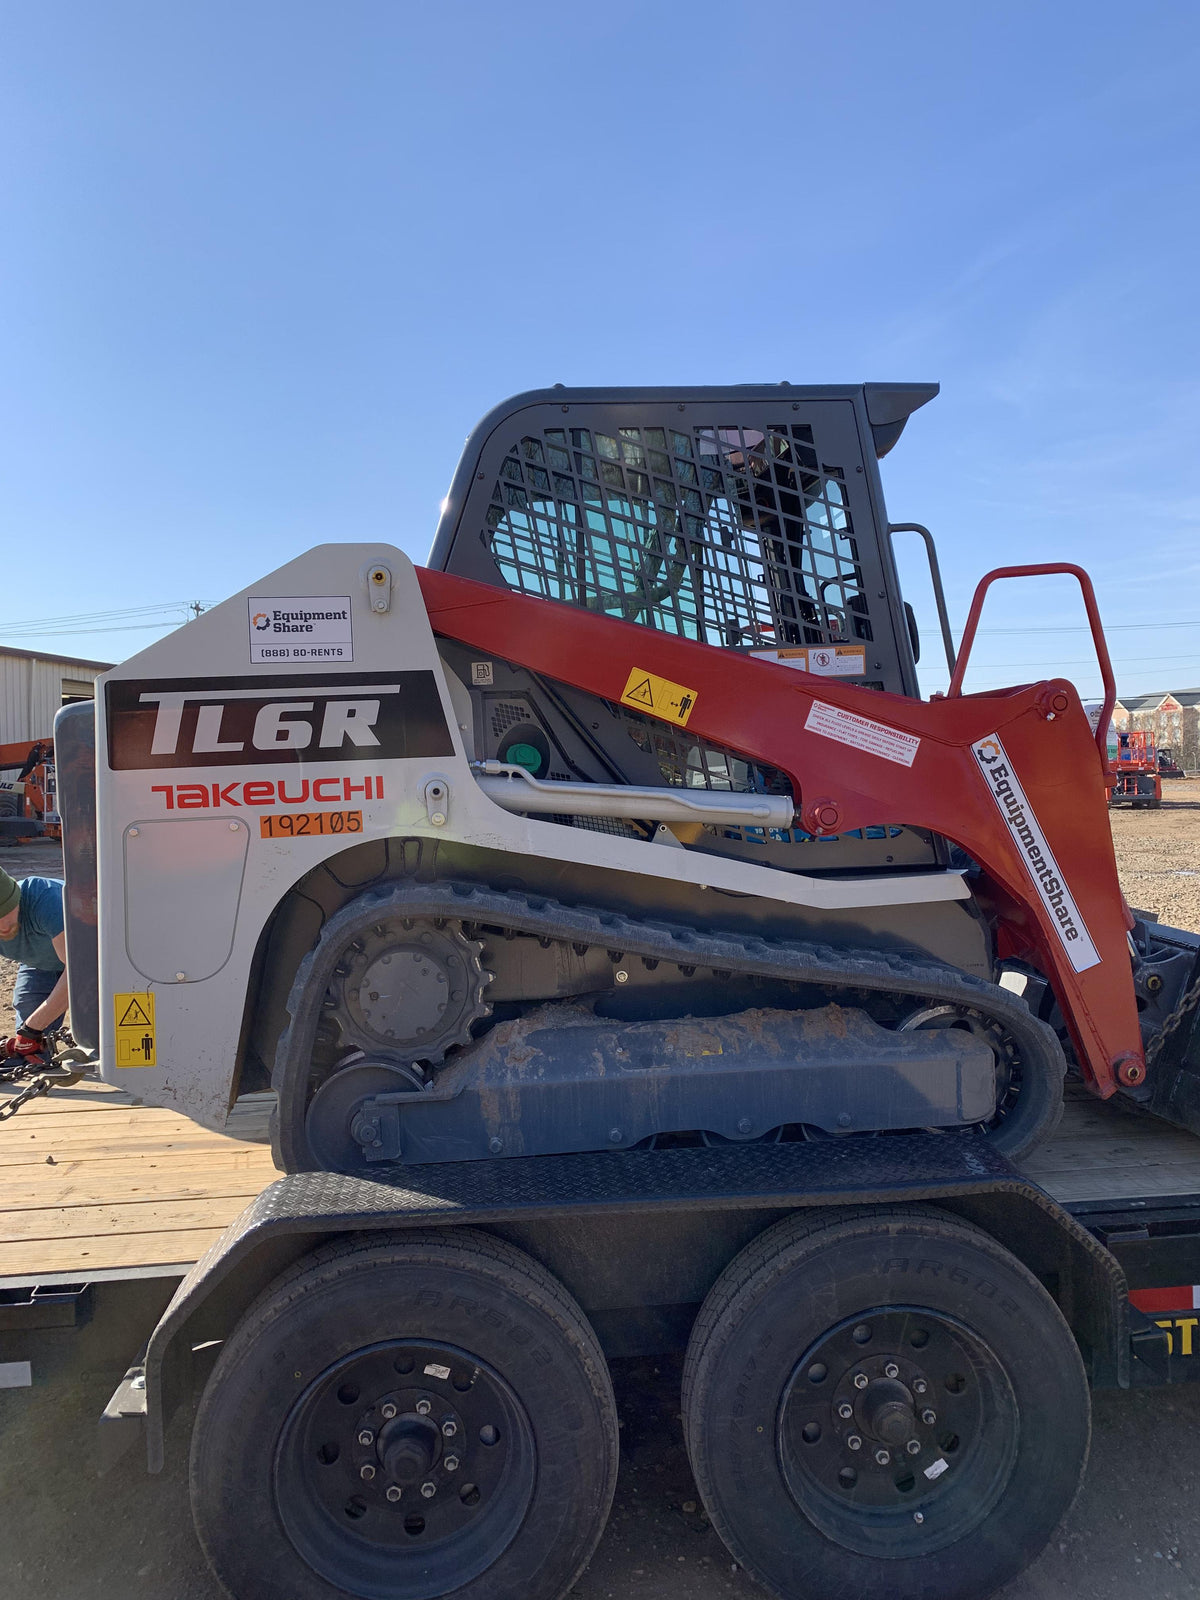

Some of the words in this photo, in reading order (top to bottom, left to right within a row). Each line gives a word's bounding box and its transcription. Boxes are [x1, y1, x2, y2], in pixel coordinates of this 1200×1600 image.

[272, 610, 348, 623] Equipment
[273, 622, 313, 633] Share
[261, 648, 290, 658] (888)
[293, 648, 343, 657] 80-RENTS
[139, 684, 400, 755] TL6R
[837, 711, 869, 727] CUSTOMER
[869, 723, 918, 745] RESPONSIBILITY
[263, 811, 361, 837] 192105
[990, 764, 1078, 942] EquipmentShare
